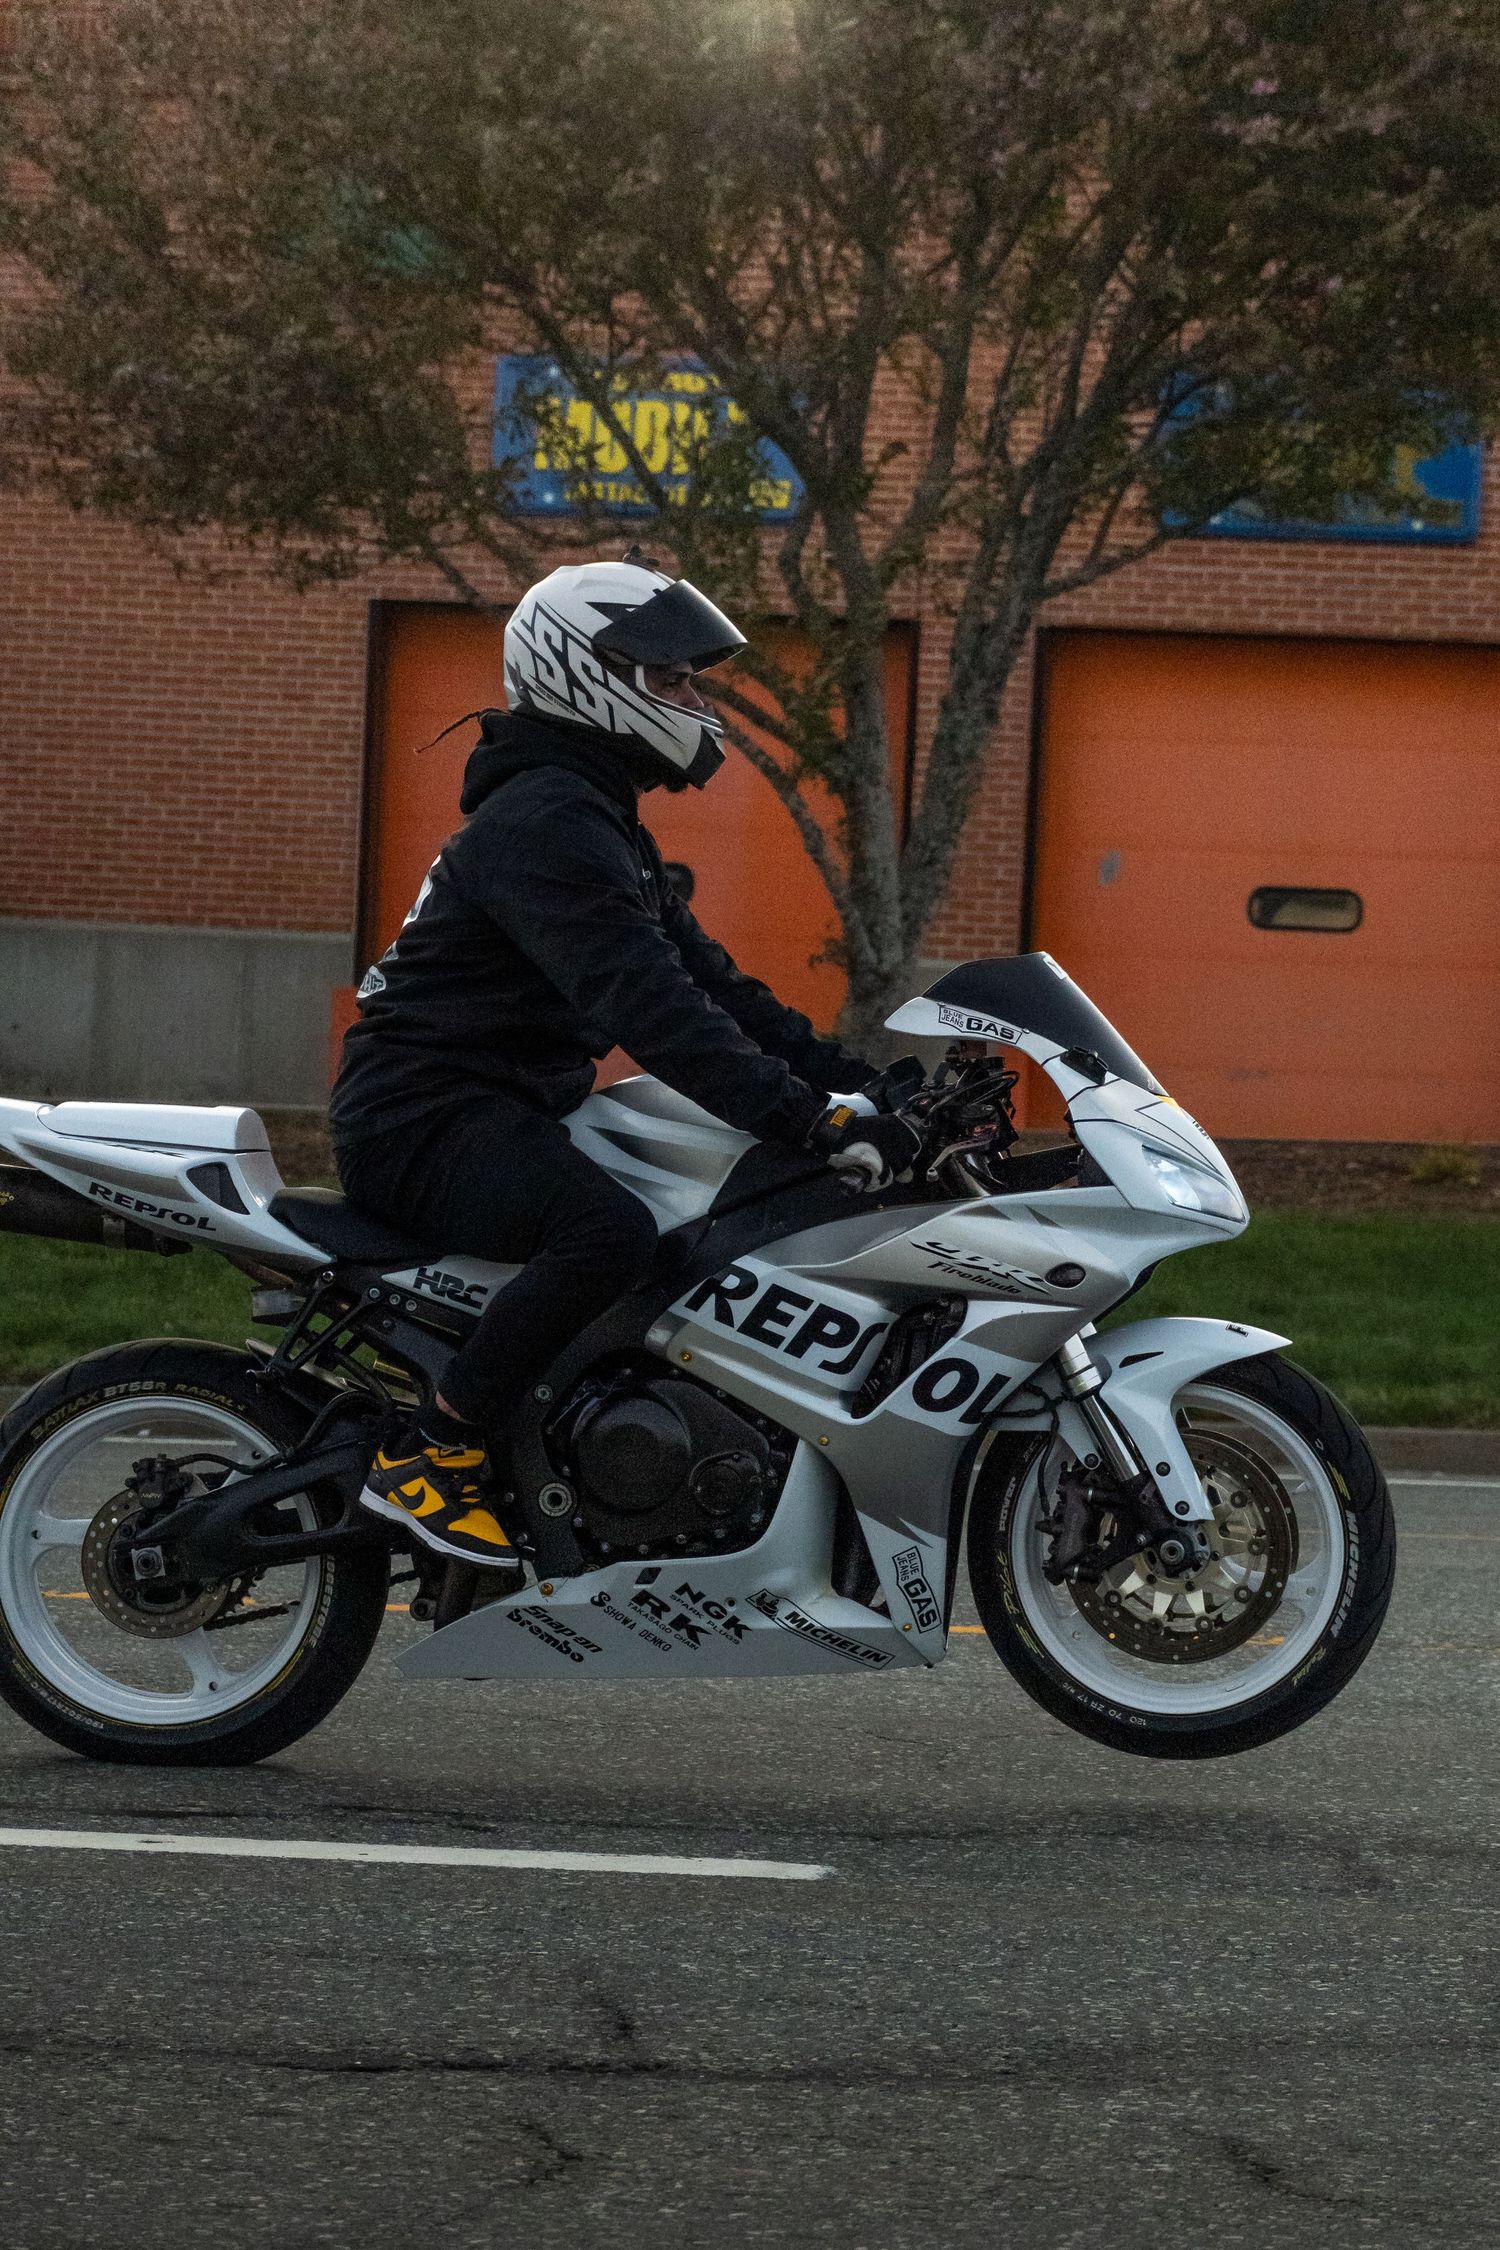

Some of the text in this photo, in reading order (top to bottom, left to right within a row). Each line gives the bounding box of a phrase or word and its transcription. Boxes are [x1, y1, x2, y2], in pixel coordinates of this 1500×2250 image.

[942, 1014, 964, 1028] JEANS
[943, 1009, 963, 1019] BLUE
[966, 1017, 1014, 1040] GAS
[89, 1181, 216, 1231] REPSOL
[413, 1267, 488, 1310] HRC
[927, 1261, 1022, 1294] Fireblade
[897, 1556, 910, 1582] JEANS
[907, 1552, 919, 1576] BLUE
[1330, 1509, 1359, 1639] MICHELIN
[630, 1589, 713, 1646] RK
[669, 1594, 741, 1645] SPARK PLUGS
[674, 1582, 753, 1640] NGK
[903, 1578, 937, 1627] GAS
[506, 1608, 584, 1663] brembo
[603, 1605, 638, 1631] SHOWA
[638, 1629, 672, 1652] DENKO
[626, 1602, 699, 1651] TAKASAGO CHAIN
[784, 1611, 888, 1662] MICHELIN
[1108, 1709, 1122, 1720] 70
[1129, 1715, 1147, 1726] 120
